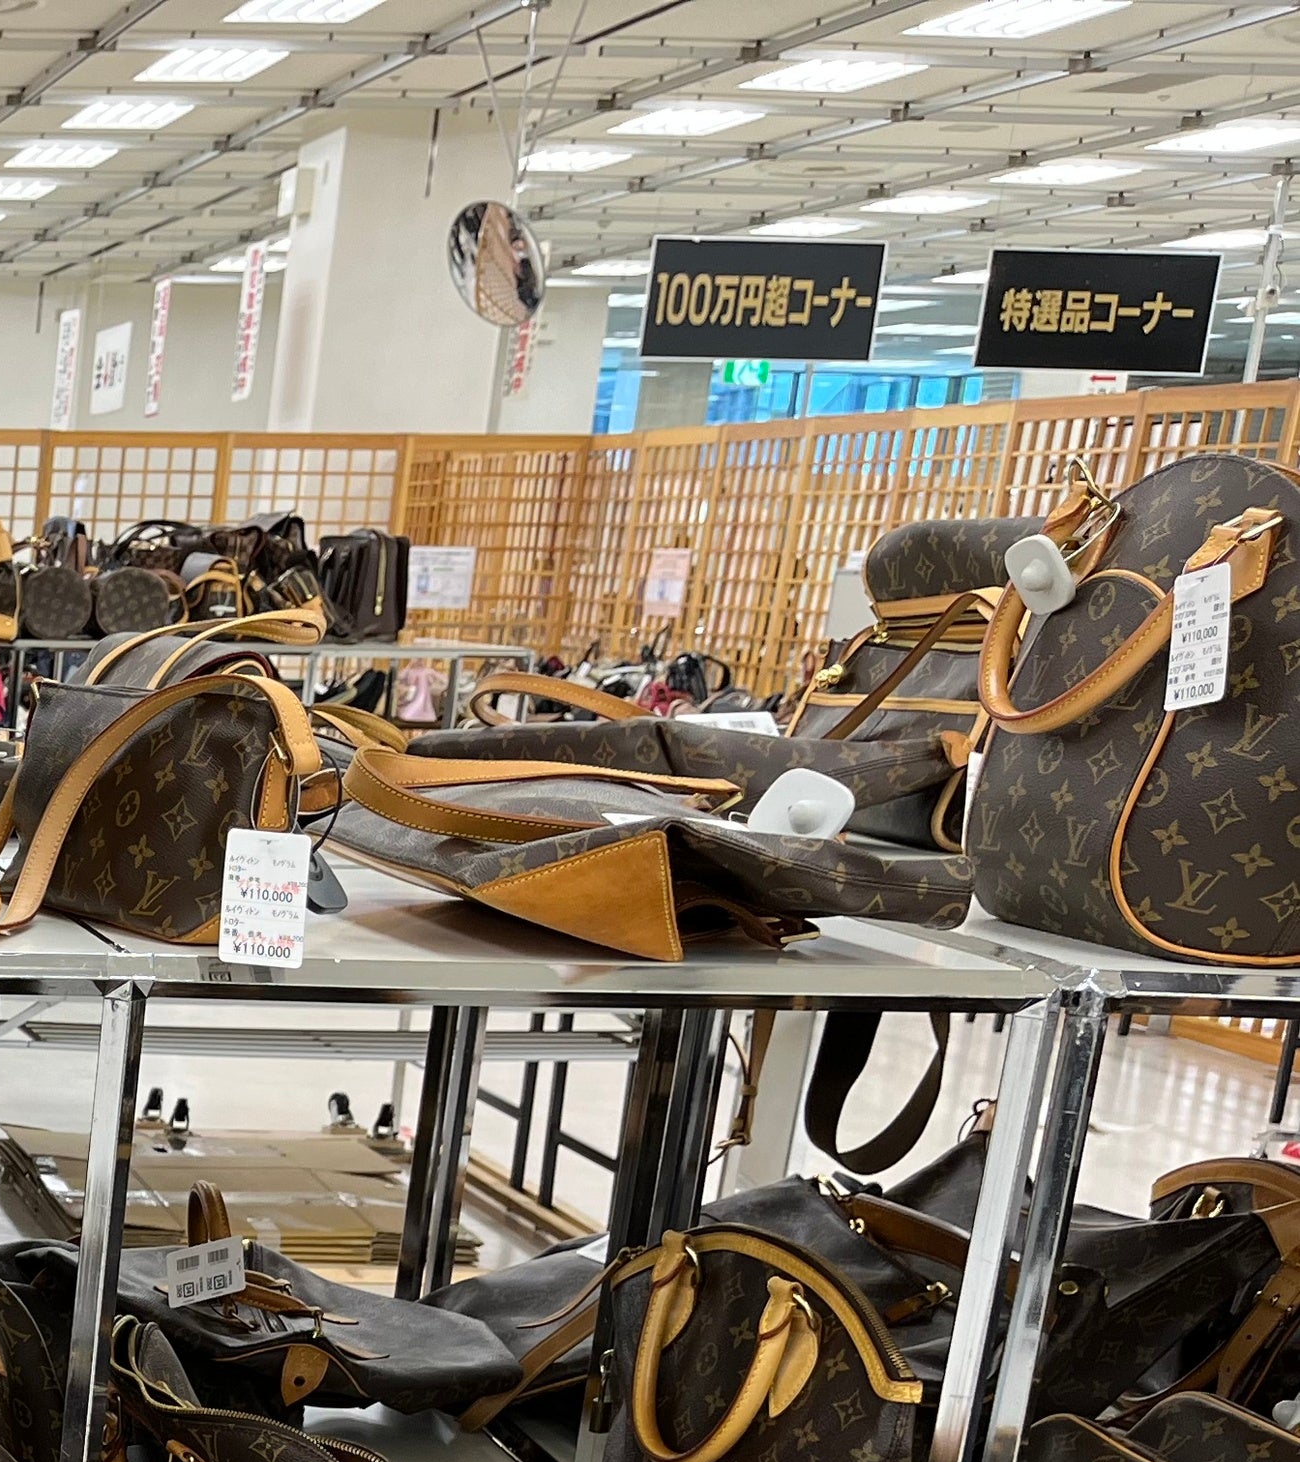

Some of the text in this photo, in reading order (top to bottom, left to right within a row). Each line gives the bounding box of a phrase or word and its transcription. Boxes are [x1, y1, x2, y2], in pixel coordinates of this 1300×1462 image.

[654, 272, 873, 328] 100万円超コーナー
[1000, 287, 1195, 335] 特選品コーナー
[1182, 625, 1218, 644] ¥110,000
[1174, 682, 1215, 701] ¥110,000
[240, 887, 293, 903] ¥110,000
[233, 941, 291, 959] ¥110,000
